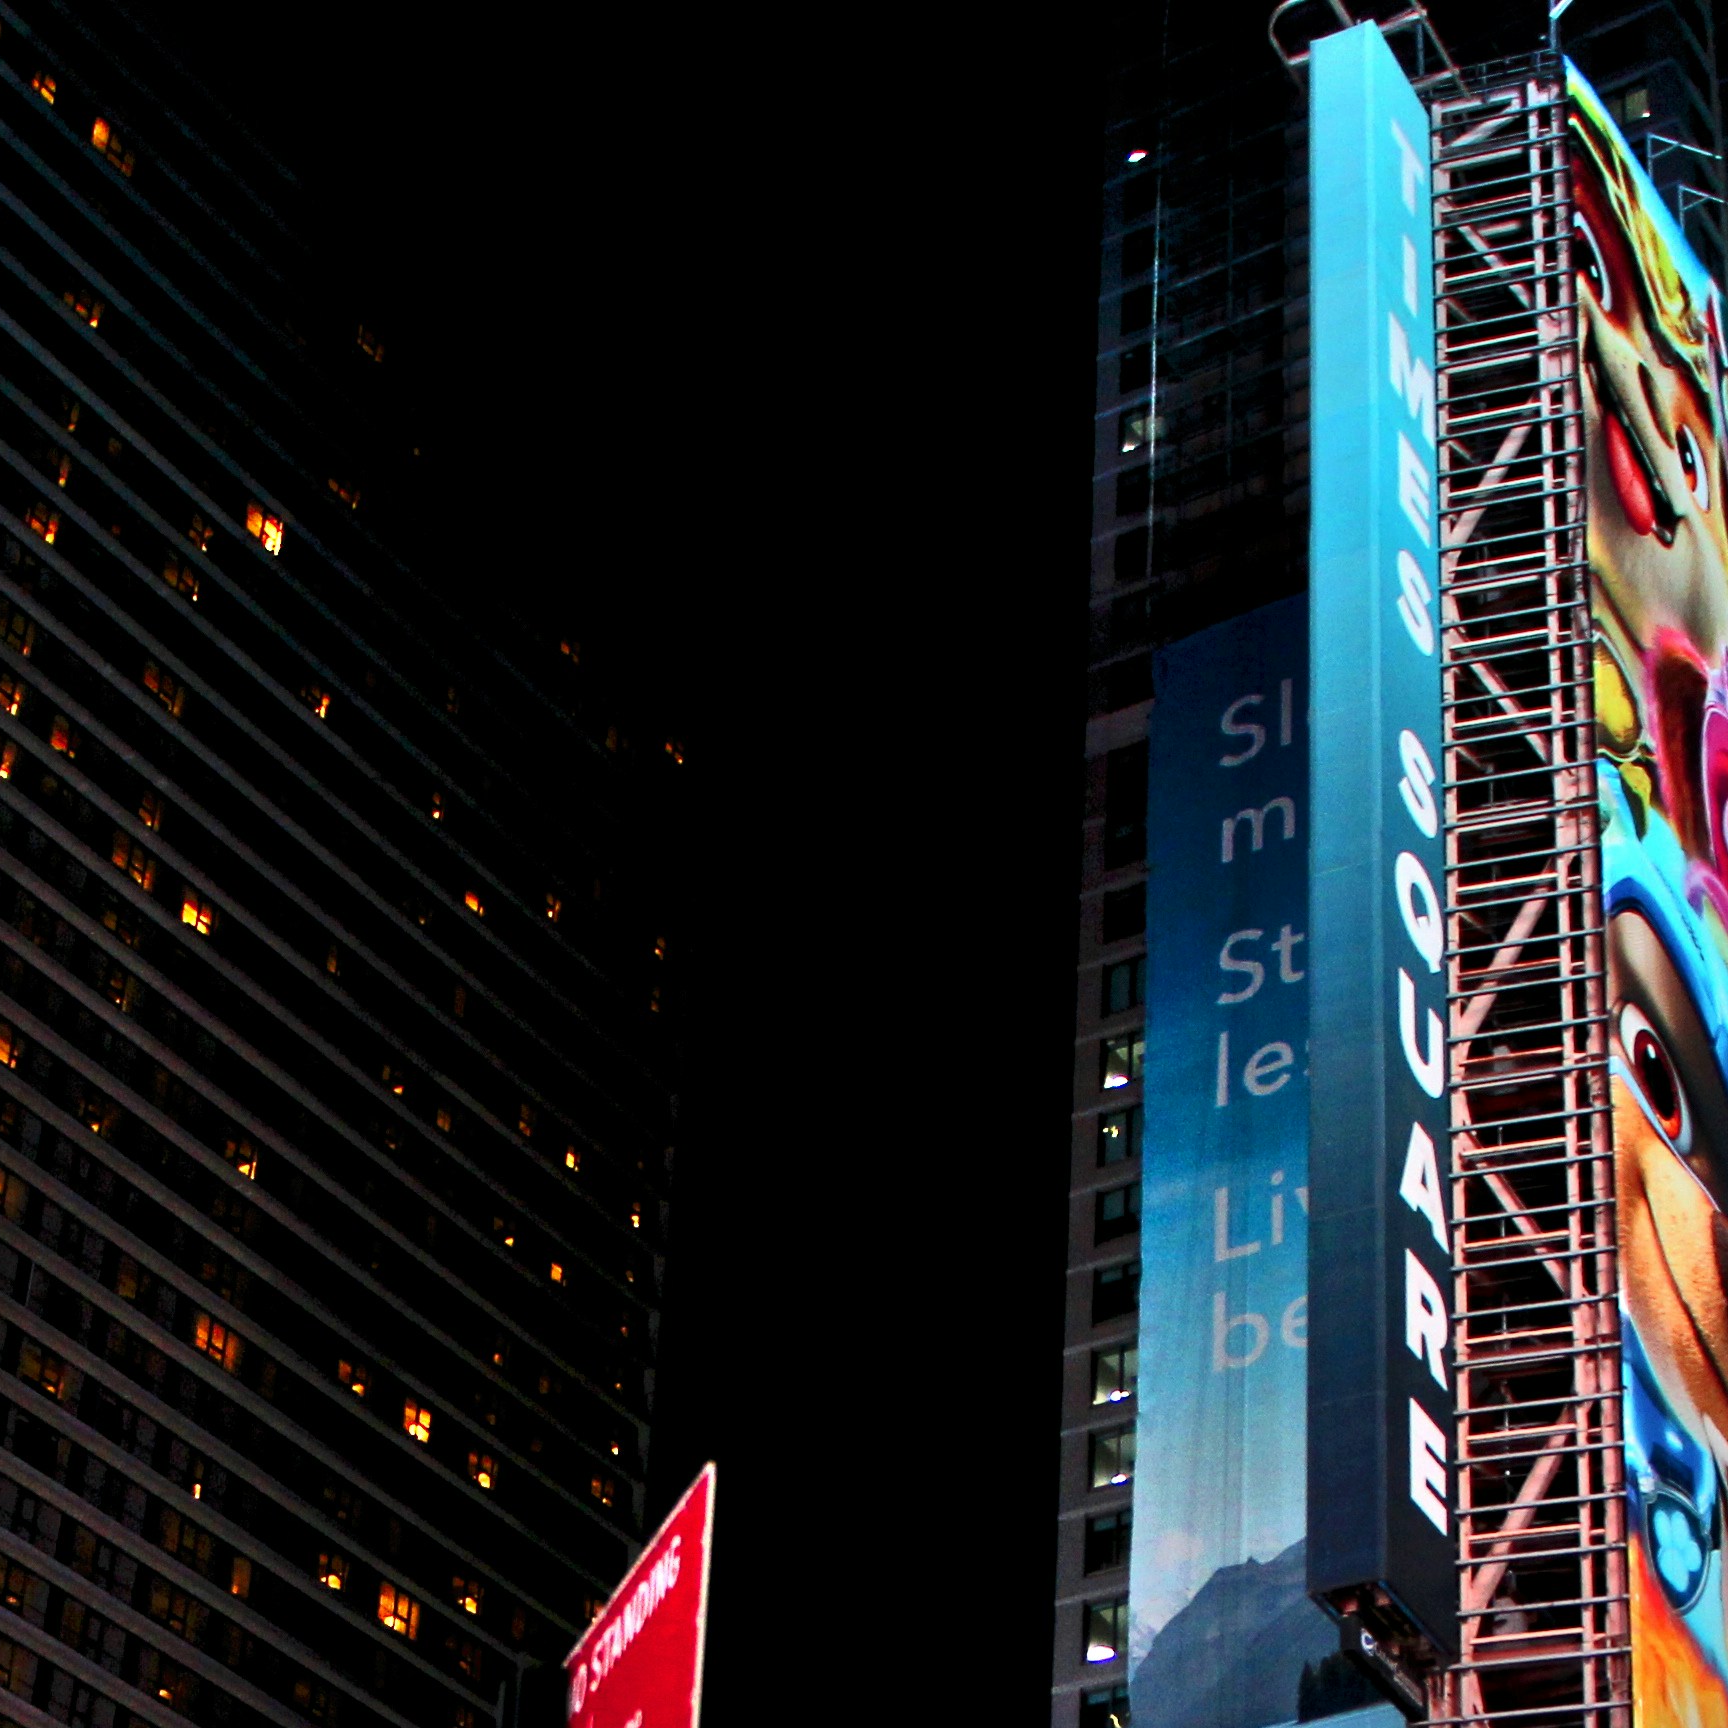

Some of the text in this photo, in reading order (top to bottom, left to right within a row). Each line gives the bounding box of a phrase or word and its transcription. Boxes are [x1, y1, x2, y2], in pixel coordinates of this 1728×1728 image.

[1388, 119, 1436, 658] TIMES
[1394, 728, 1450, 1536] SQUARE
[590, 1534, 681, 1693] STANDING
